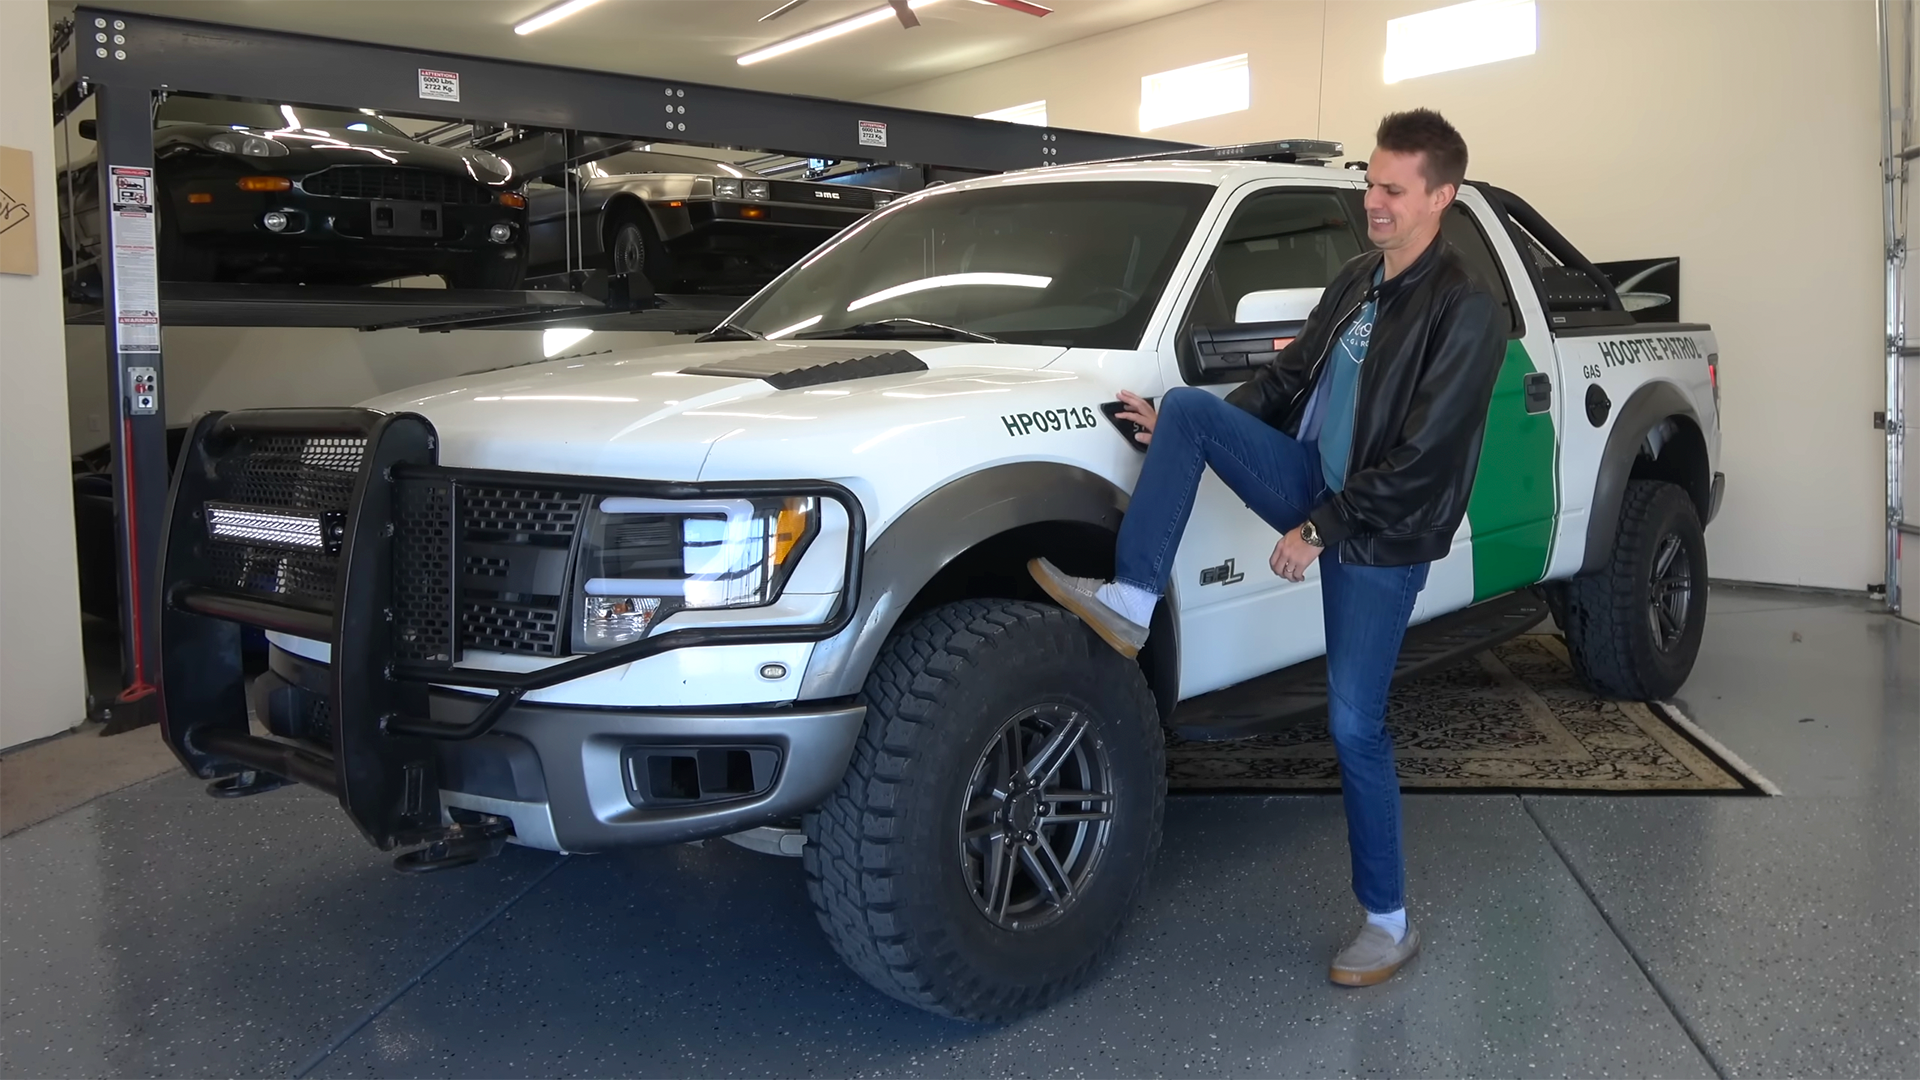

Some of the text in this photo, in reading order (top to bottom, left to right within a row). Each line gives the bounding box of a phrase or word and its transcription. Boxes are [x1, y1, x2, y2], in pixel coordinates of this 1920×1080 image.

[1598, 337, 1702, 368] HOOPTIE PATROL
[1583, 364, 1601, 379] GAS
[1001, 406, 1097, 437] HP09716
